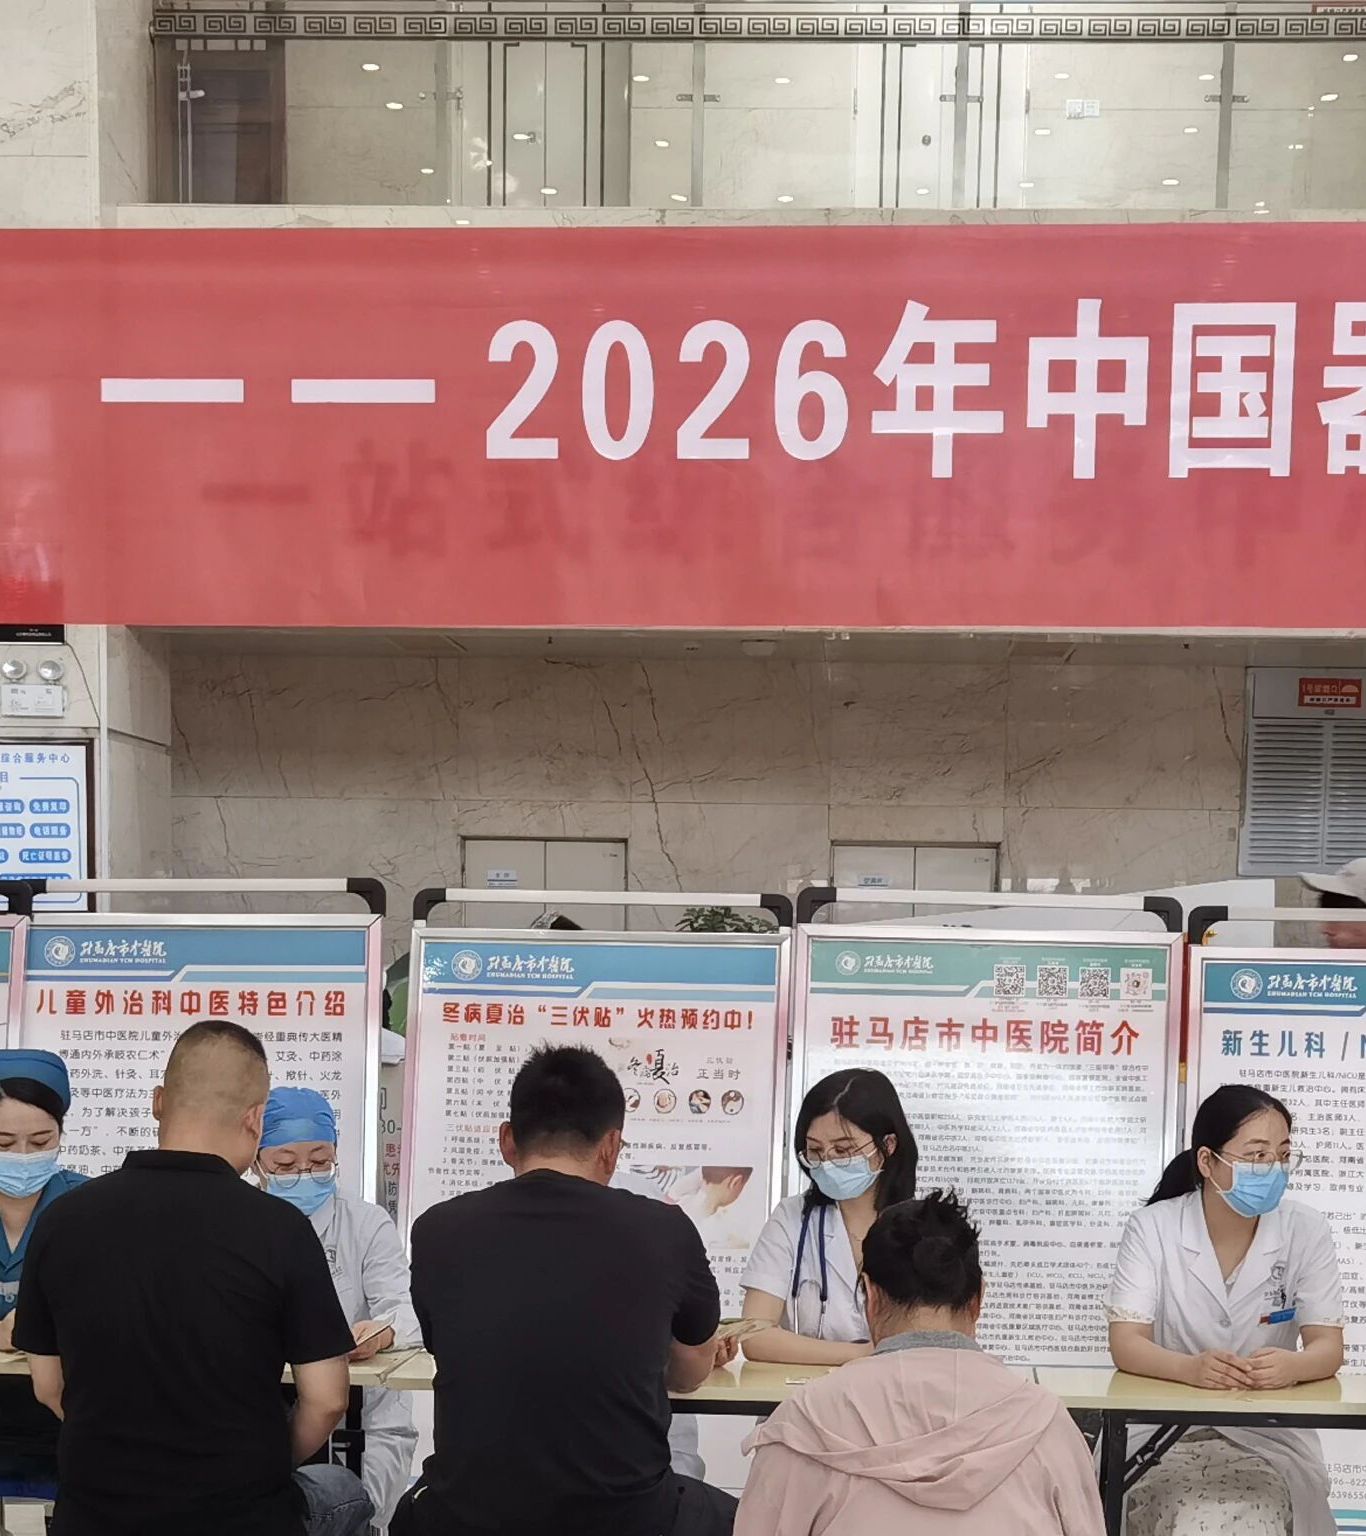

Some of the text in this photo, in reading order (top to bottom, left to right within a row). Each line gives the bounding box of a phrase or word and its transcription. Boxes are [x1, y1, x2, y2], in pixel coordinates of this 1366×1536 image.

[35, 989, 347, 1017] 儿童外治科中医特色介绍
[829, 1015, 1140, 1057] 驻马店市中医院简介
[696, 1068, 741, 1080] 正当时
